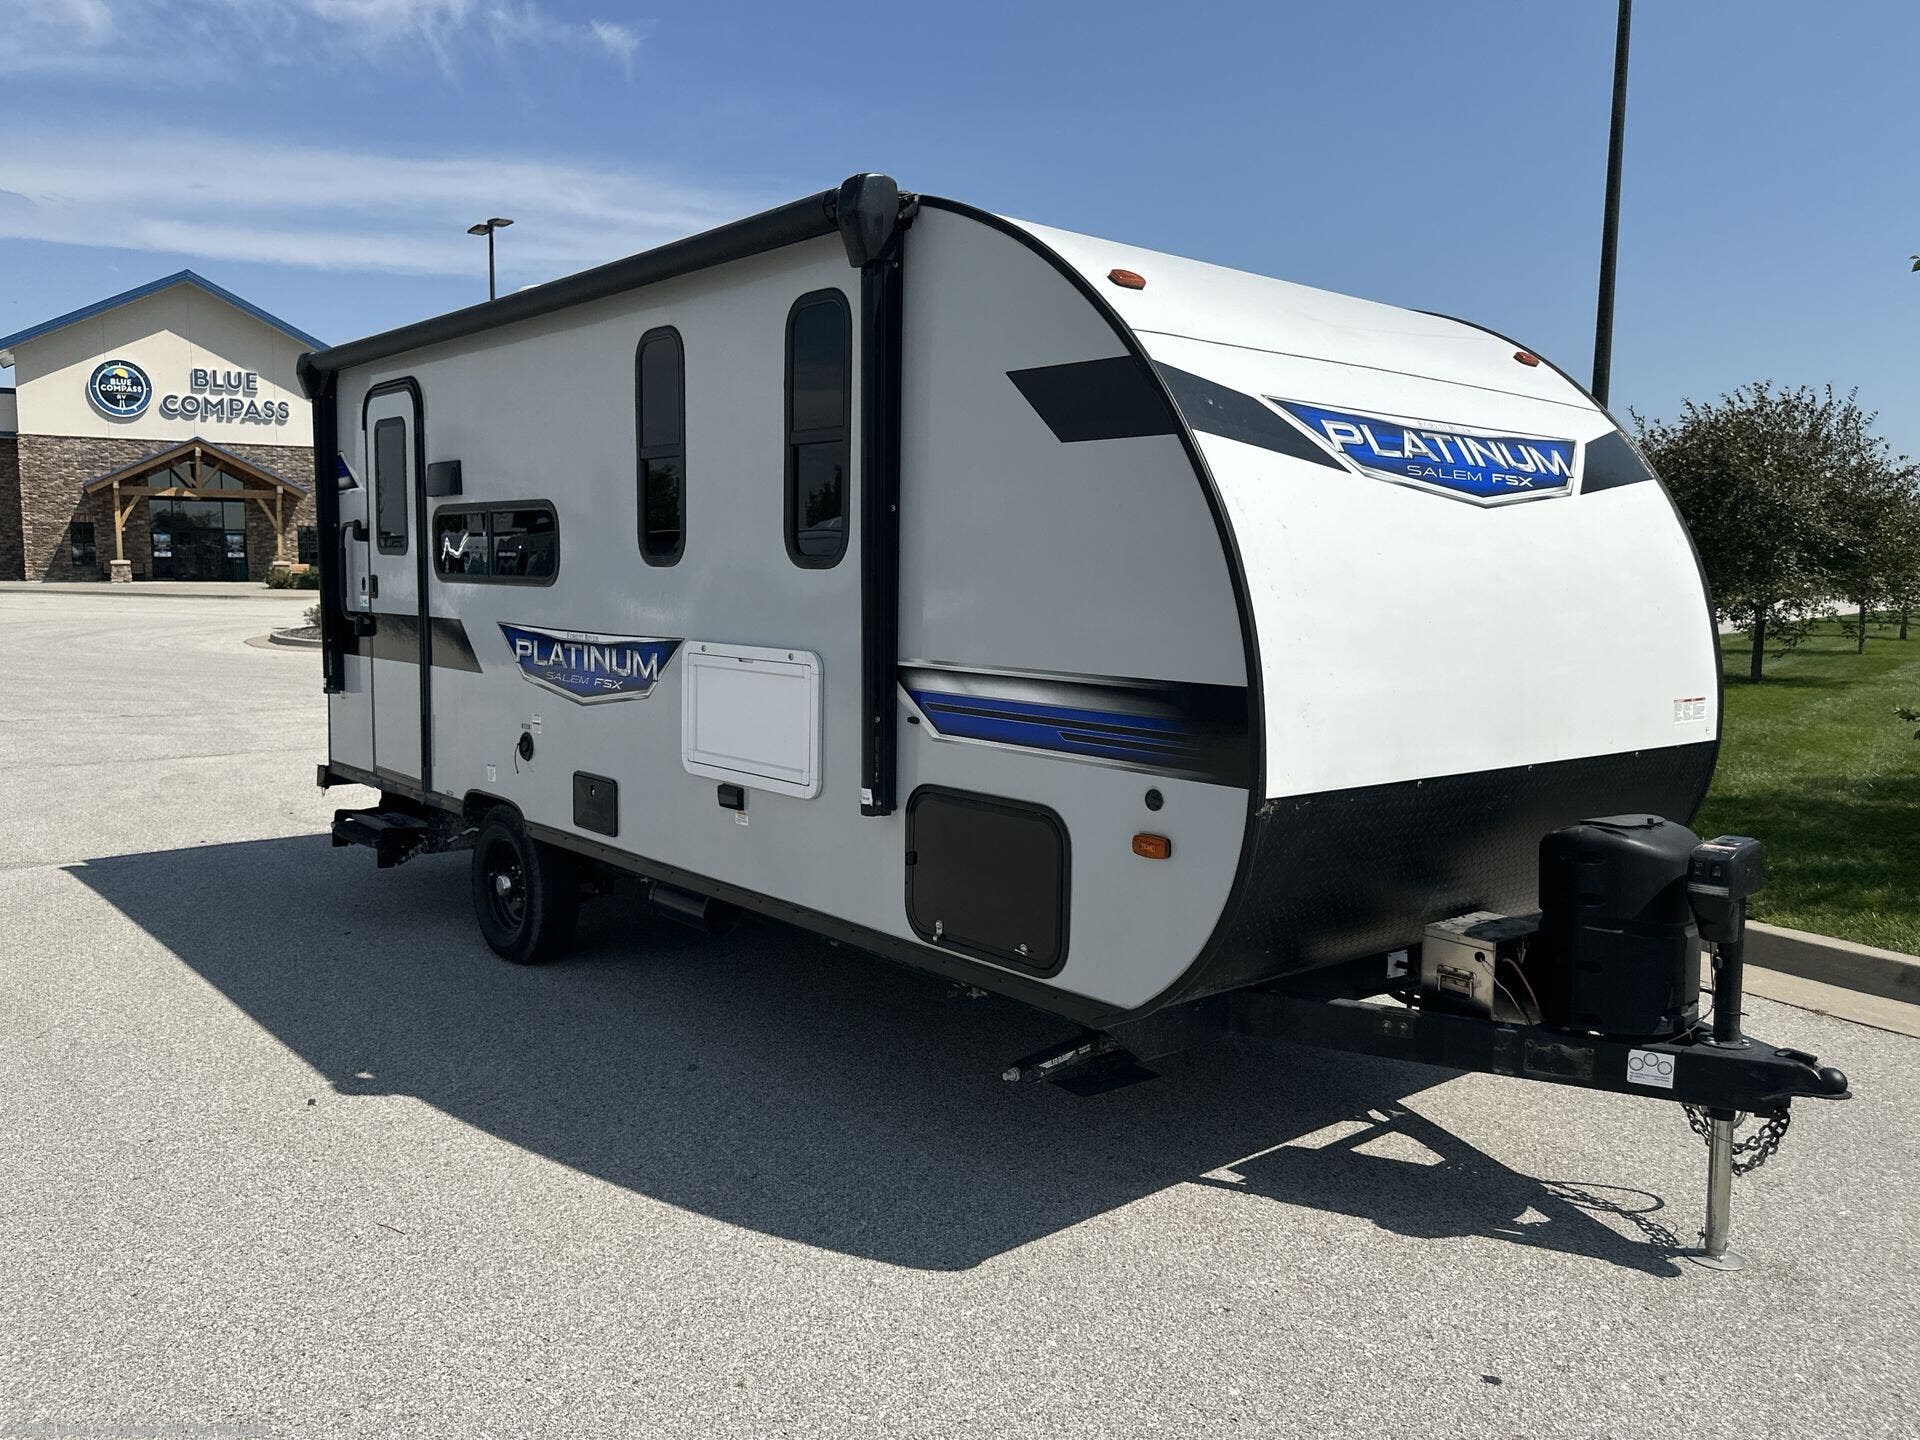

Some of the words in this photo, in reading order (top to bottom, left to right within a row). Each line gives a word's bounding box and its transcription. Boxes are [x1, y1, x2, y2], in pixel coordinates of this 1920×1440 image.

[100, 384, 143, 393] COMPASS
[110, 378, 132, 386] BLUE
[193, 368, 258, 391] BLUE
[161, 394, 290, 419] COMPASS
[1320, 419, 1574, 478] PLATINUM
[1406, 465, 1482, 482] SALEM
[1491, 473, 1534, 488] FSX
[515, 638, 658, 682] PLATINUM
[546, 671, 590, 685] SALEM
[594, 677, 624, 690] FSX
